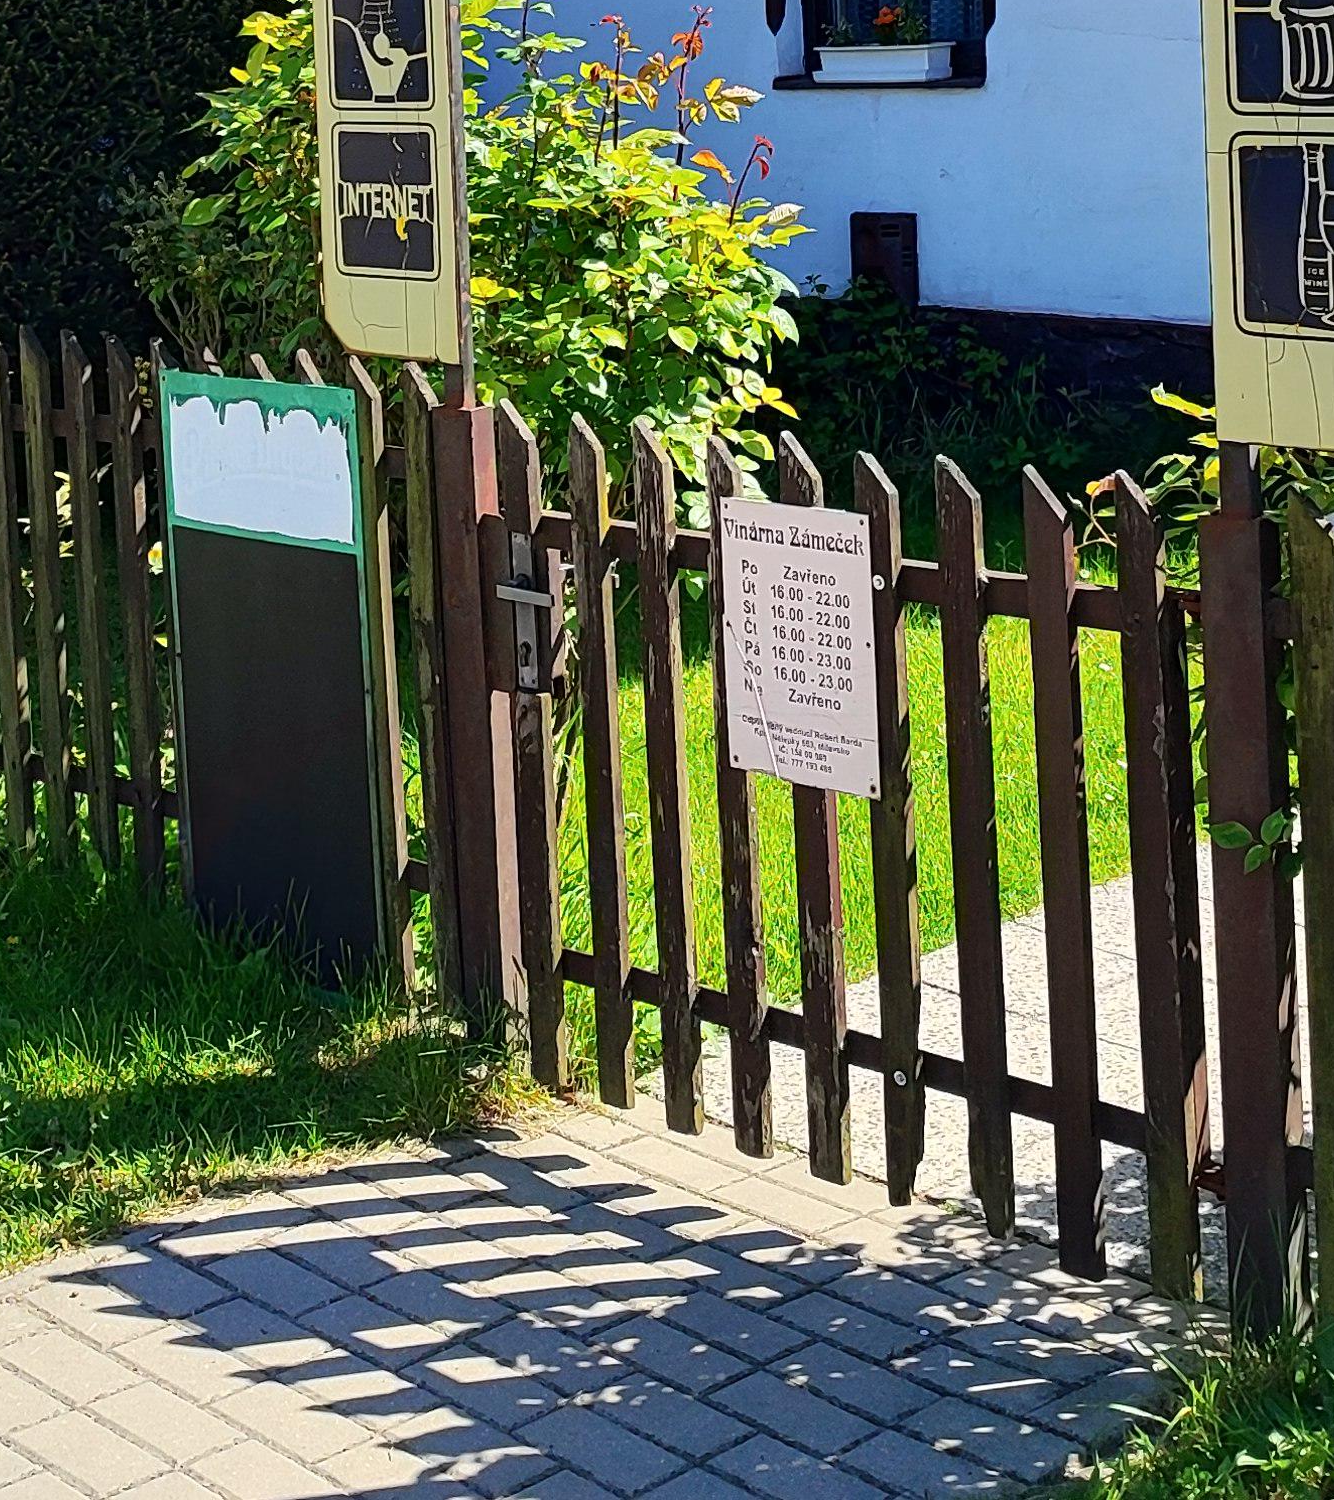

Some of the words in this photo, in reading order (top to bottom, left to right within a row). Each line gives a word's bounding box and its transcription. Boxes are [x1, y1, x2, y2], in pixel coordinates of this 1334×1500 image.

[342, 181, 431, 222] INTERNET
[723, 517, 785, 546] Vinárna
[788, 525, 865, 557] Zámeček
[741, 559, 758, 575] Po
[783, 565, 836, 587] Zavřeno
[770, 584, 804, 602] 16.00
[815, 590, 850, 609] 22.00
[771, 604, 804, 622] 16.00
[815, 611, 850, 630] 22.00
[772, 624, 805, 643] 16.00
[817, 632, 852, 651] 22.00
[745, 639, 760, 656] Pá
[772, 645, 805, 663] 16.00
[816, 652, 851, 671] 23.00
[773, 665, 806, 684] 16.00
[818, 673, 853, 692] 23.00
[788, 688, 842, 711] Zavřeno
